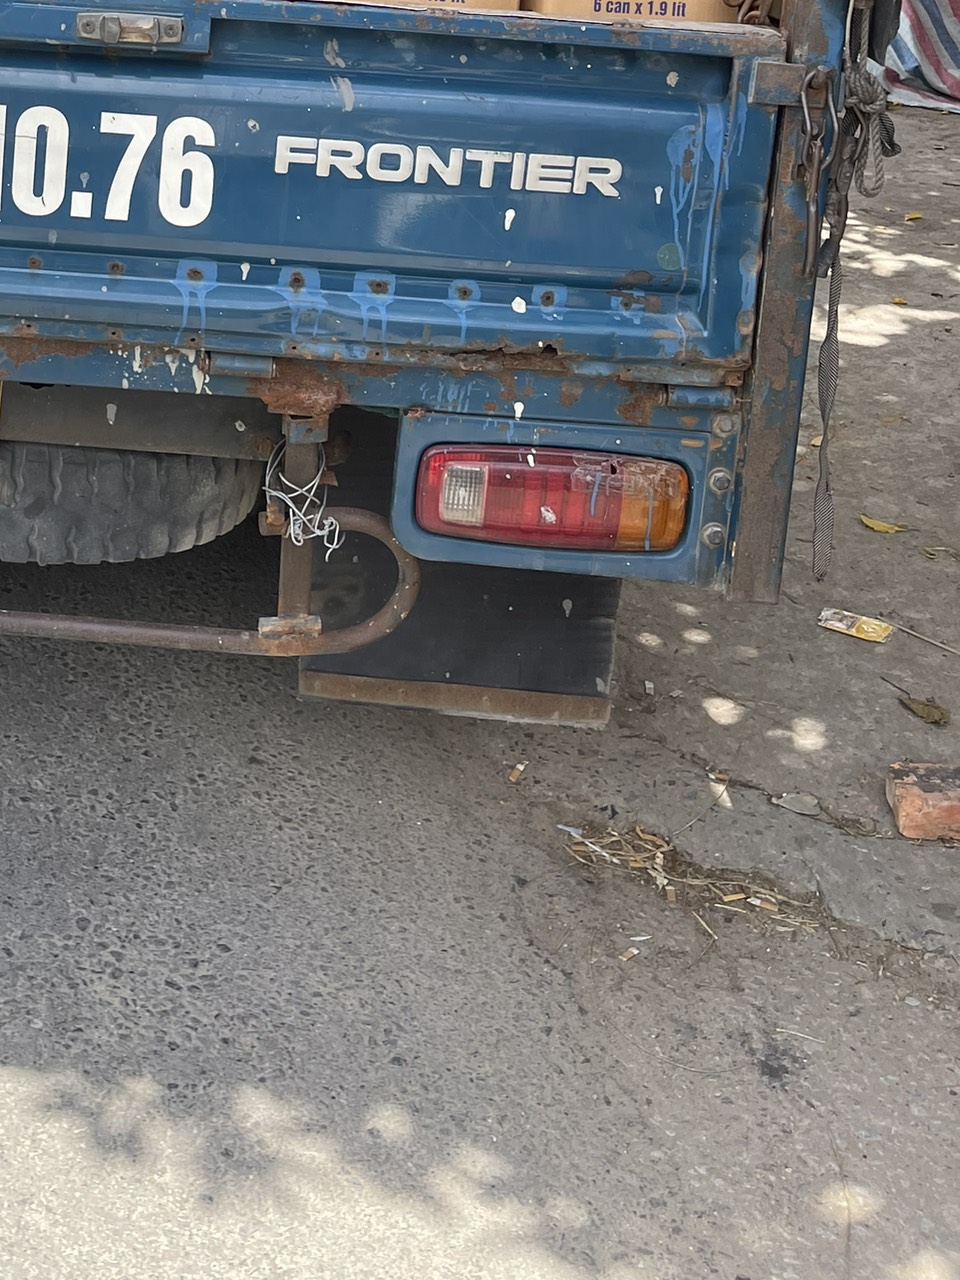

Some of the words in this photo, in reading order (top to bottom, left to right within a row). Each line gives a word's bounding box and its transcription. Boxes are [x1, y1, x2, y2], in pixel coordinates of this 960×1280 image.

[605, 0, 630, 14] can
[634, 2, 642, 15] x
[647, 0, 668, 16] 1.9
[671, 1, 686, 17] lít
[274, 134, 623, 198] FRONTIER
